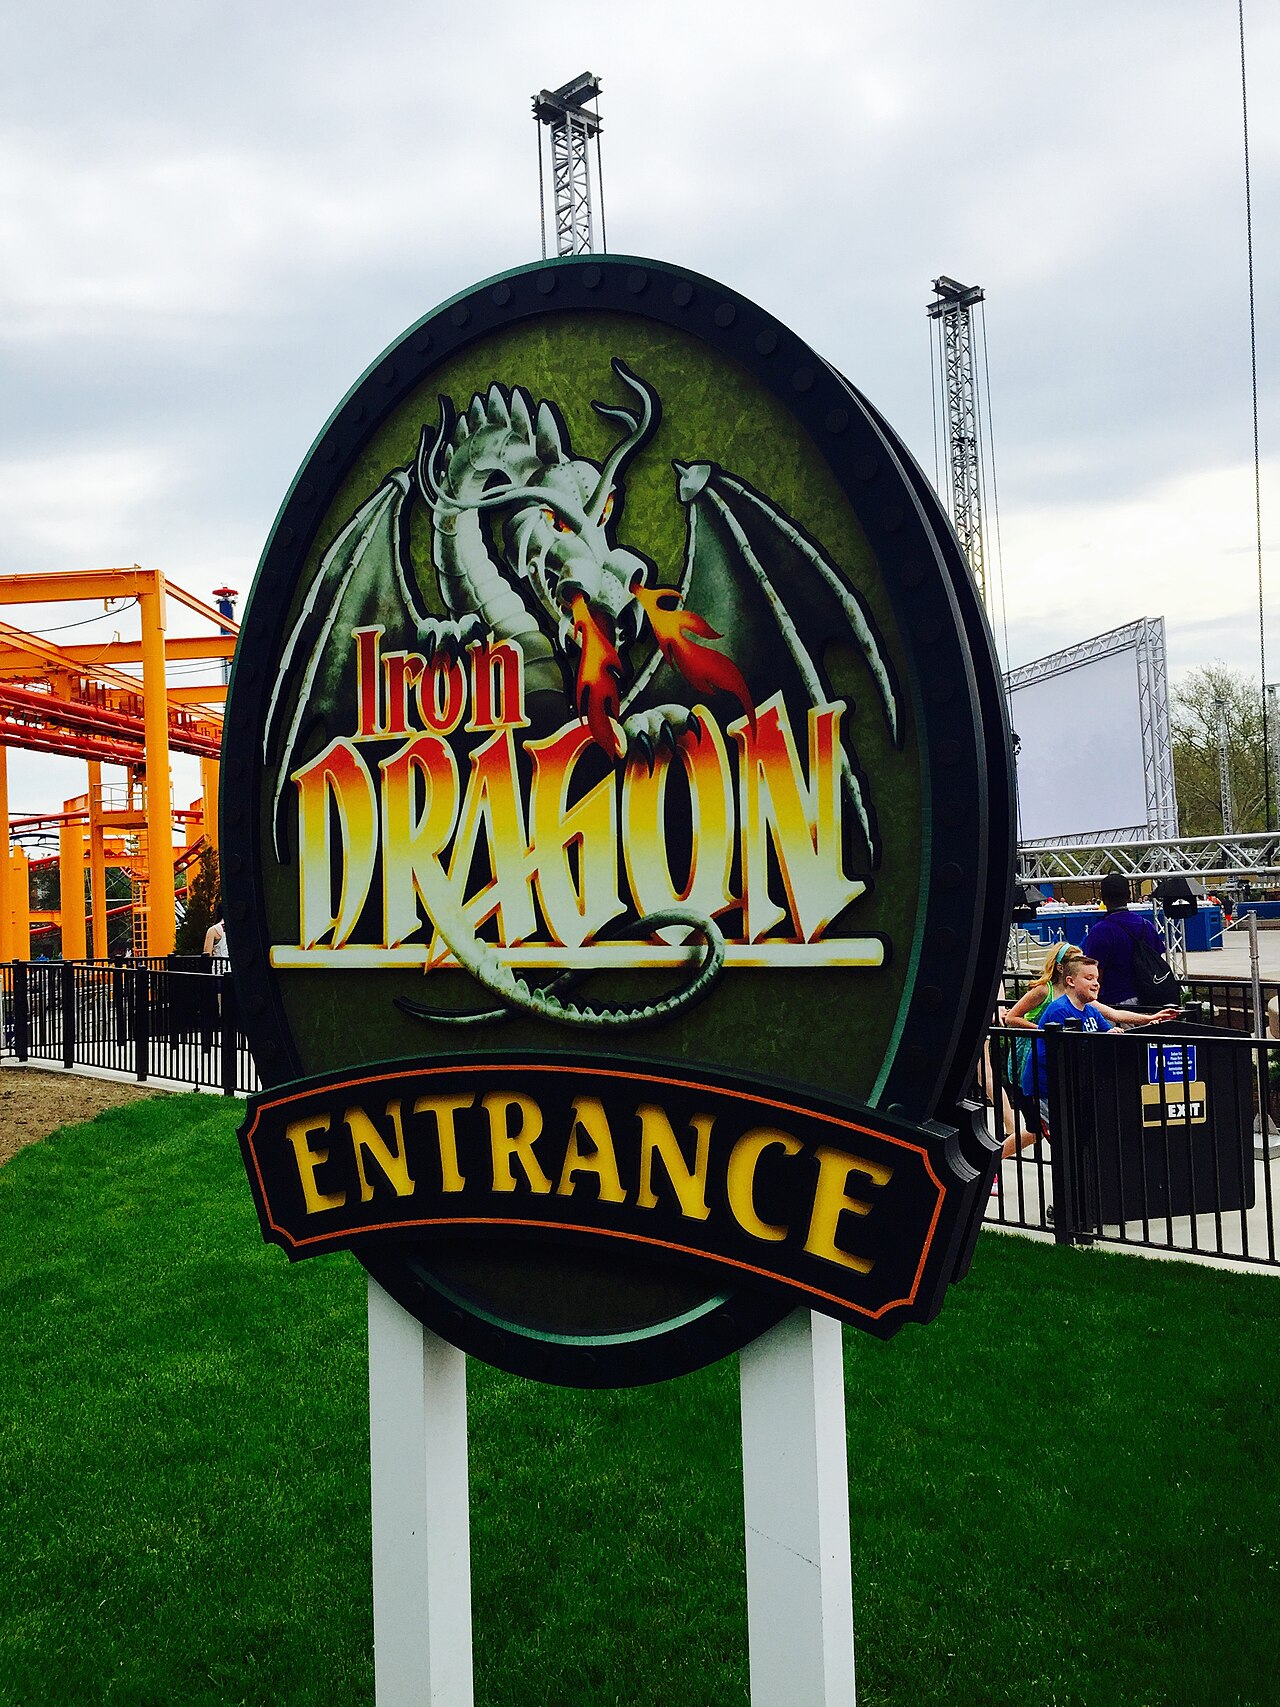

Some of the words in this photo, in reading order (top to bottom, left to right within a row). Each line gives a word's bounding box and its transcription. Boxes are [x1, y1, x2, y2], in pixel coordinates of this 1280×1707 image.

[351, 624, 531, 742] Iron
[291, 690, 866, 974] DRAGON
[285, 1091, 896, 1275] ENTRANCE
[1167, 1102, 1201, 1118] EXIT
